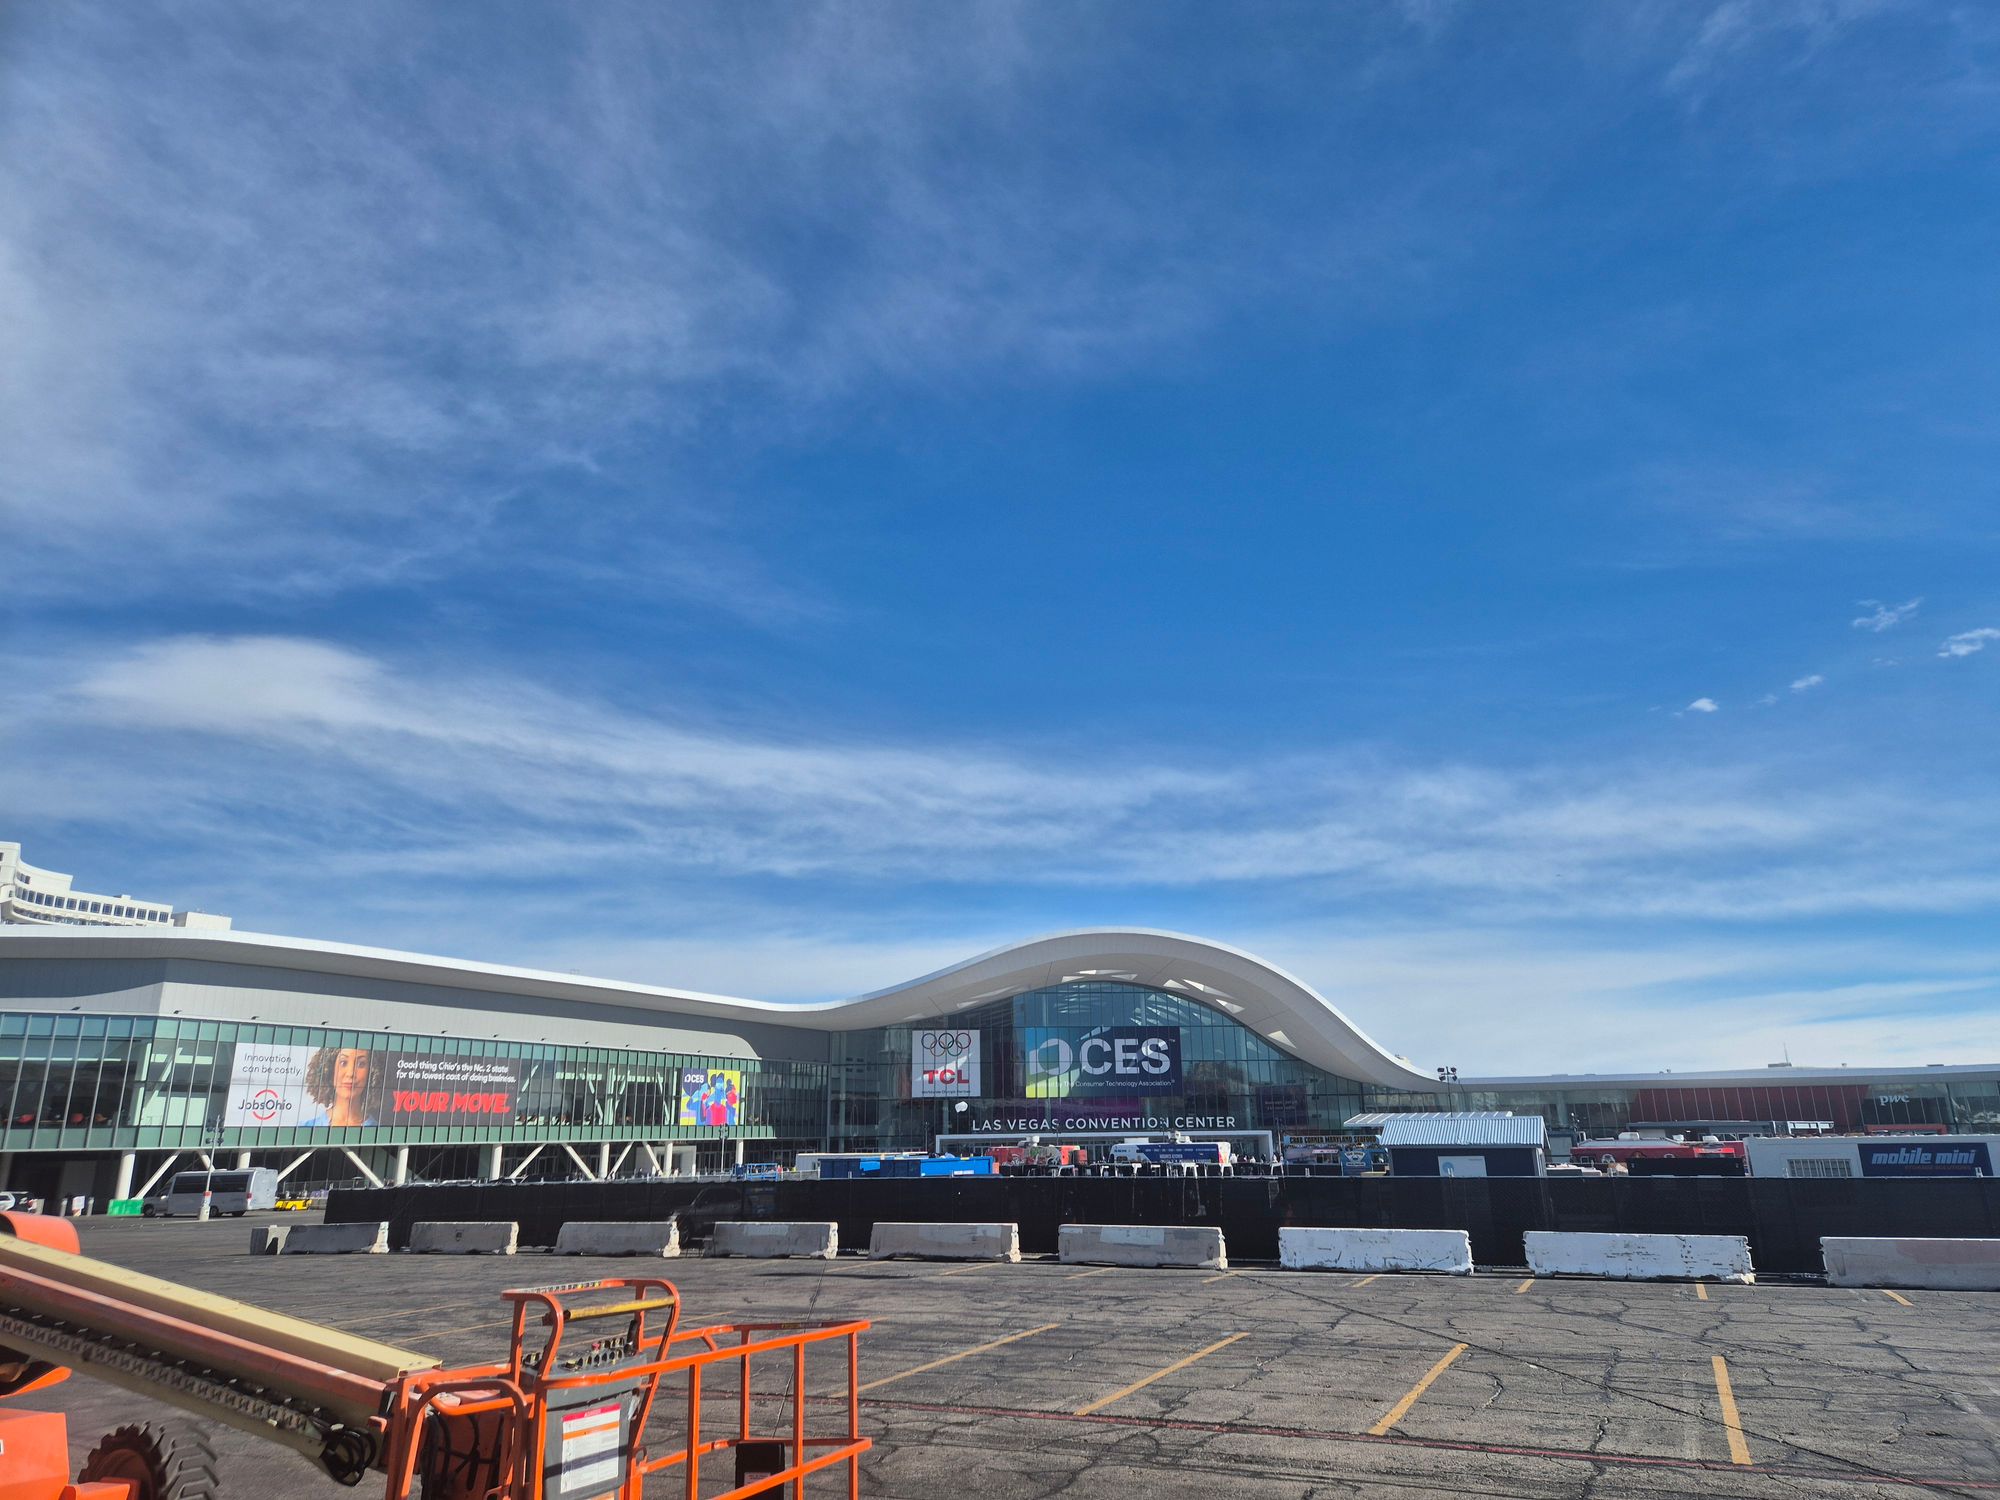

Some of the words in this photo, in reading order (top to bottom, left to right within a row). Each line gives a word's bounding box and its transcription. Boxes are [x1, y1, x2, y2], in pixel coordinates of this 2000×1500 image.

[244, 1052, 292, 1063] Innovation
[1080, 1037, 1171, 1075] CES
[242, 1065, 259, 1074] can
[261, 1064, 272, 1074] be
[274, 1065, 302, 1077] costly.
[397, 1060, 418, 1069] Good
[419, 1060, 437, 1072] thing
[438, 1061, 461, 1071] Ohio's
[461, 1063, 472, 1072] the
[485, 1064, 492, 1073] 2
[396, 1069, 407, 1079] for
[408, 1069, 420, 1080] the
[421, 1070, 445, 1080] lowest
[461, 1072, 469, 1081] of
[469, 1072, 488, 1084] doing
[923, 1069, 970, 1085] TCL
[1075, 1080, 1105, 1088] Consumer
[1105, 1080, 1138, 1089] Technology
[238, 1099, 292, 1111] JobsOhio
[392, 1090, 450, 1113] YOUR
[450, 1092, 511, 1114] MOVE.
[1879, 1094, 1910, 1106] pwc
[972, 1119, 1001, 1131] LAS
[1007, 1118, 1060, 1131] VEGAS
[1065, 1117, 1170, 1130] CONVENTION
[1174, 1115, 1236, 1129] CENTER
[1871, 1147, 1932, 1165] mobile
[1935, 1149, 1977, 1165] mini
